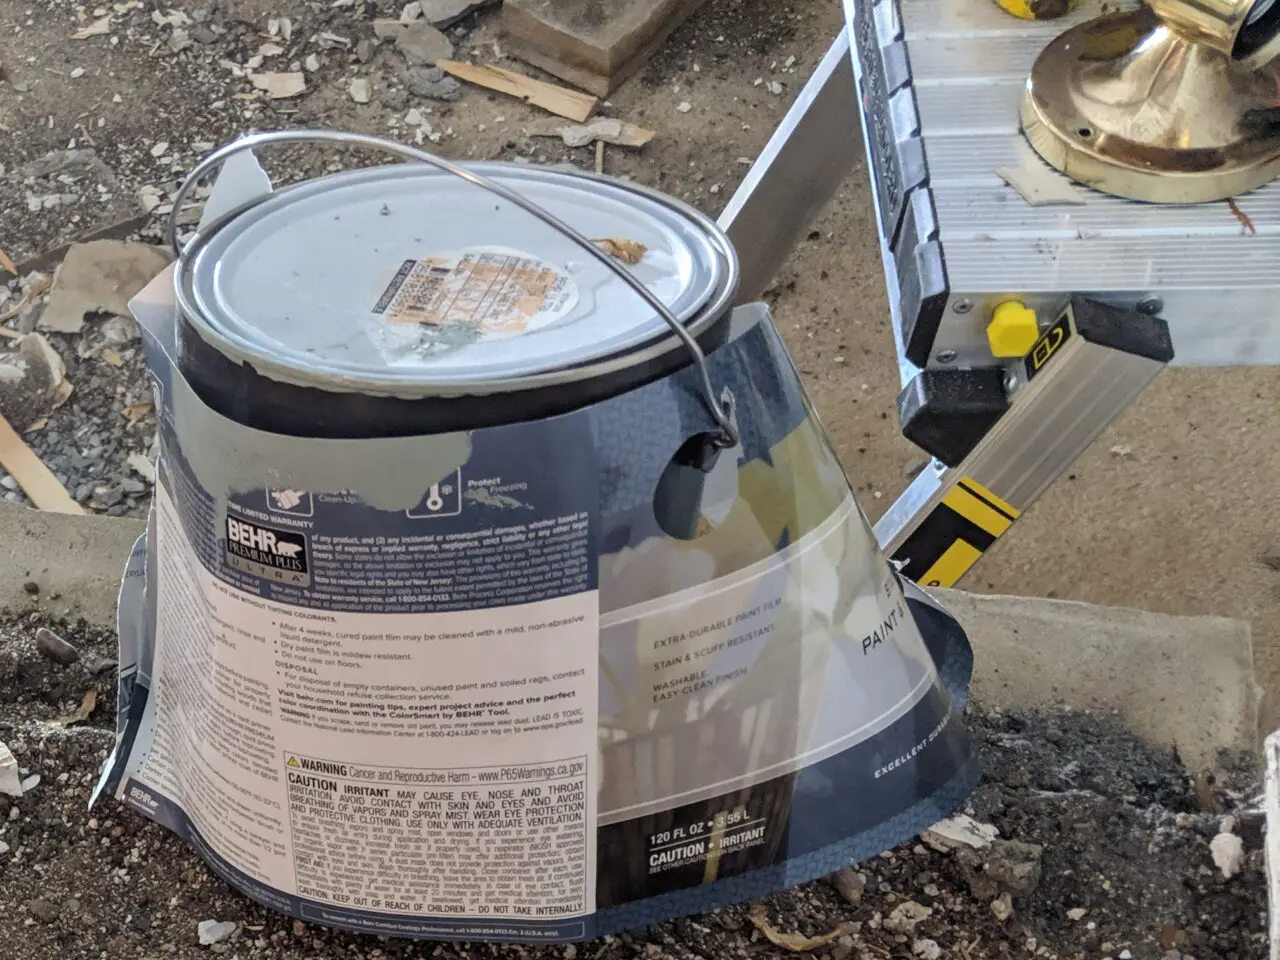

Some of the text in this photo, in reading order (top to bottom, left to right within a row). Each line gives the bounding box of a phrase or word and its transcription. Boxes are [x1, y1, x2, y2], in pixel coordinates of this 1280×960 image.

[468, 477, 500, 487] Protect
[243, 508, 268, 520] LIMITED
[270, 515, 314, 528] WARRANTY
[228, 518, 277, 553] BEHR
[230, 540, 272, 565] PREMIUM
[276, 556, 301, 570] PLUS
[280, 622, 297, 631] After
[306, 629, 333, 638] weeks,
[362, 634, 383, 642] paint
[438, 632, 473, 640] cleaned
[505, 626, 525, 634] mild,
[528, 615, 585, 631] non-abrasive
[653, 597, 782, 649] EXTRA-DURABLE PAINT FILM
[862, 611, 898, 655] PAINT
[281, 641, 294, 650] Dry
[296, 645, 315, 654] paint
[317, 648, 331, 656] film
[342, 651, 372, 660] mildew
[282, 651, 293, 659] Do
[294, 654, 307, 662] not
[309, 656, 323, 664] use
[338, 660, 363, 668] floors.
[653, 623, 775, 671] STAIN & SCUFF RESISTANT
[275, 660, 318, 675] DISPOSAL
[284, 672, 297, 680] For
[299, 676, 331, 687] disposal
[343, 683, 369, 691] empty
[421, 683, 453, 691] unused
[456, 683, 478, 692] paint
[480, 681, 497, 689] and
[500, 678, 526, 687] soiled
[529, 676, 550, 684] rags,
[552, 668, 585, 680] contact
[304, 685, 345, 697] household
[347, 691, 372, 700] refuse
[653, 666, 747, 703] EASY-CLEAN FINISH
[278, 688, 576, 712] Visit behr.com for painting tips, expert project advice and the perfect
[279, 697, 297, 706] color
[300, 702, 350, 715] coordination
[352, 708, 370, 717] with
[373, 709, 386, 718] the
[389, 711, 440, 720] ColorSmart
[443, 710, 453, 720] by
[533, 714, 551, 722] LEAD
[300, 758, 583, 783] WARNING Cancer and Reproductive Harm www.P65Warnings.ca.gov
[874, 739, 927, 779] EXCELLENT
[288, 772, 584, 801] CAUTION IRRITANT MAY CAUSE EYE, NOSE AND THROAT
[290, 794, 335, 810] BREATHING
[338, 803, 348, 811] OF
[352, 806, 387, 817] VAPORS
[390, 809, 409, 818] AND
[413, 811, 441, 819] SPRAY
[474, 809, 500, 819] WEAR
[505, 808, 521, 818] EYE
[526, 801, 584, 816] PROTECTION
[339, 795, 365, 805] AVOID
[371, 798, 412, 809] CONTACT
[418, 801, 441, 810] WITH
[448, 802, 469, 810] SKIN
[475, 801, 495, 810] AND
[502, 800, 525, 809] EYES
[531, 797, 551, 806] AND
[557, 791, 584, 803] AVOID
[291, 803, 306, 813] AND
[309, 806, 356, 822] PROTECTIVE
[407, 820, 423, 828] USE
[427, 821, 448, 830] ONLY
[452, 821, 474, 829] WITH
[478, 818, 523, 828] ADEQUATE
[650, 809, 750, 845] 120 FL OZ 3.55 L
[650, 827, 766, 866] CAUTION IRRITANT
[332, 893, 350, 903] KEEP
[354, 897, 368, 905] OUT
[372, 899, 381, 907] OF
[385, 901, 409, 910] REACH
[414, 903, 424, 911] OF
[428, 904, 465, 913] CHILDREN
[479, 905, 489, 913] DO
[494, 905, 508, 914] NOT
[512, 907, 532, 915] TAKE
